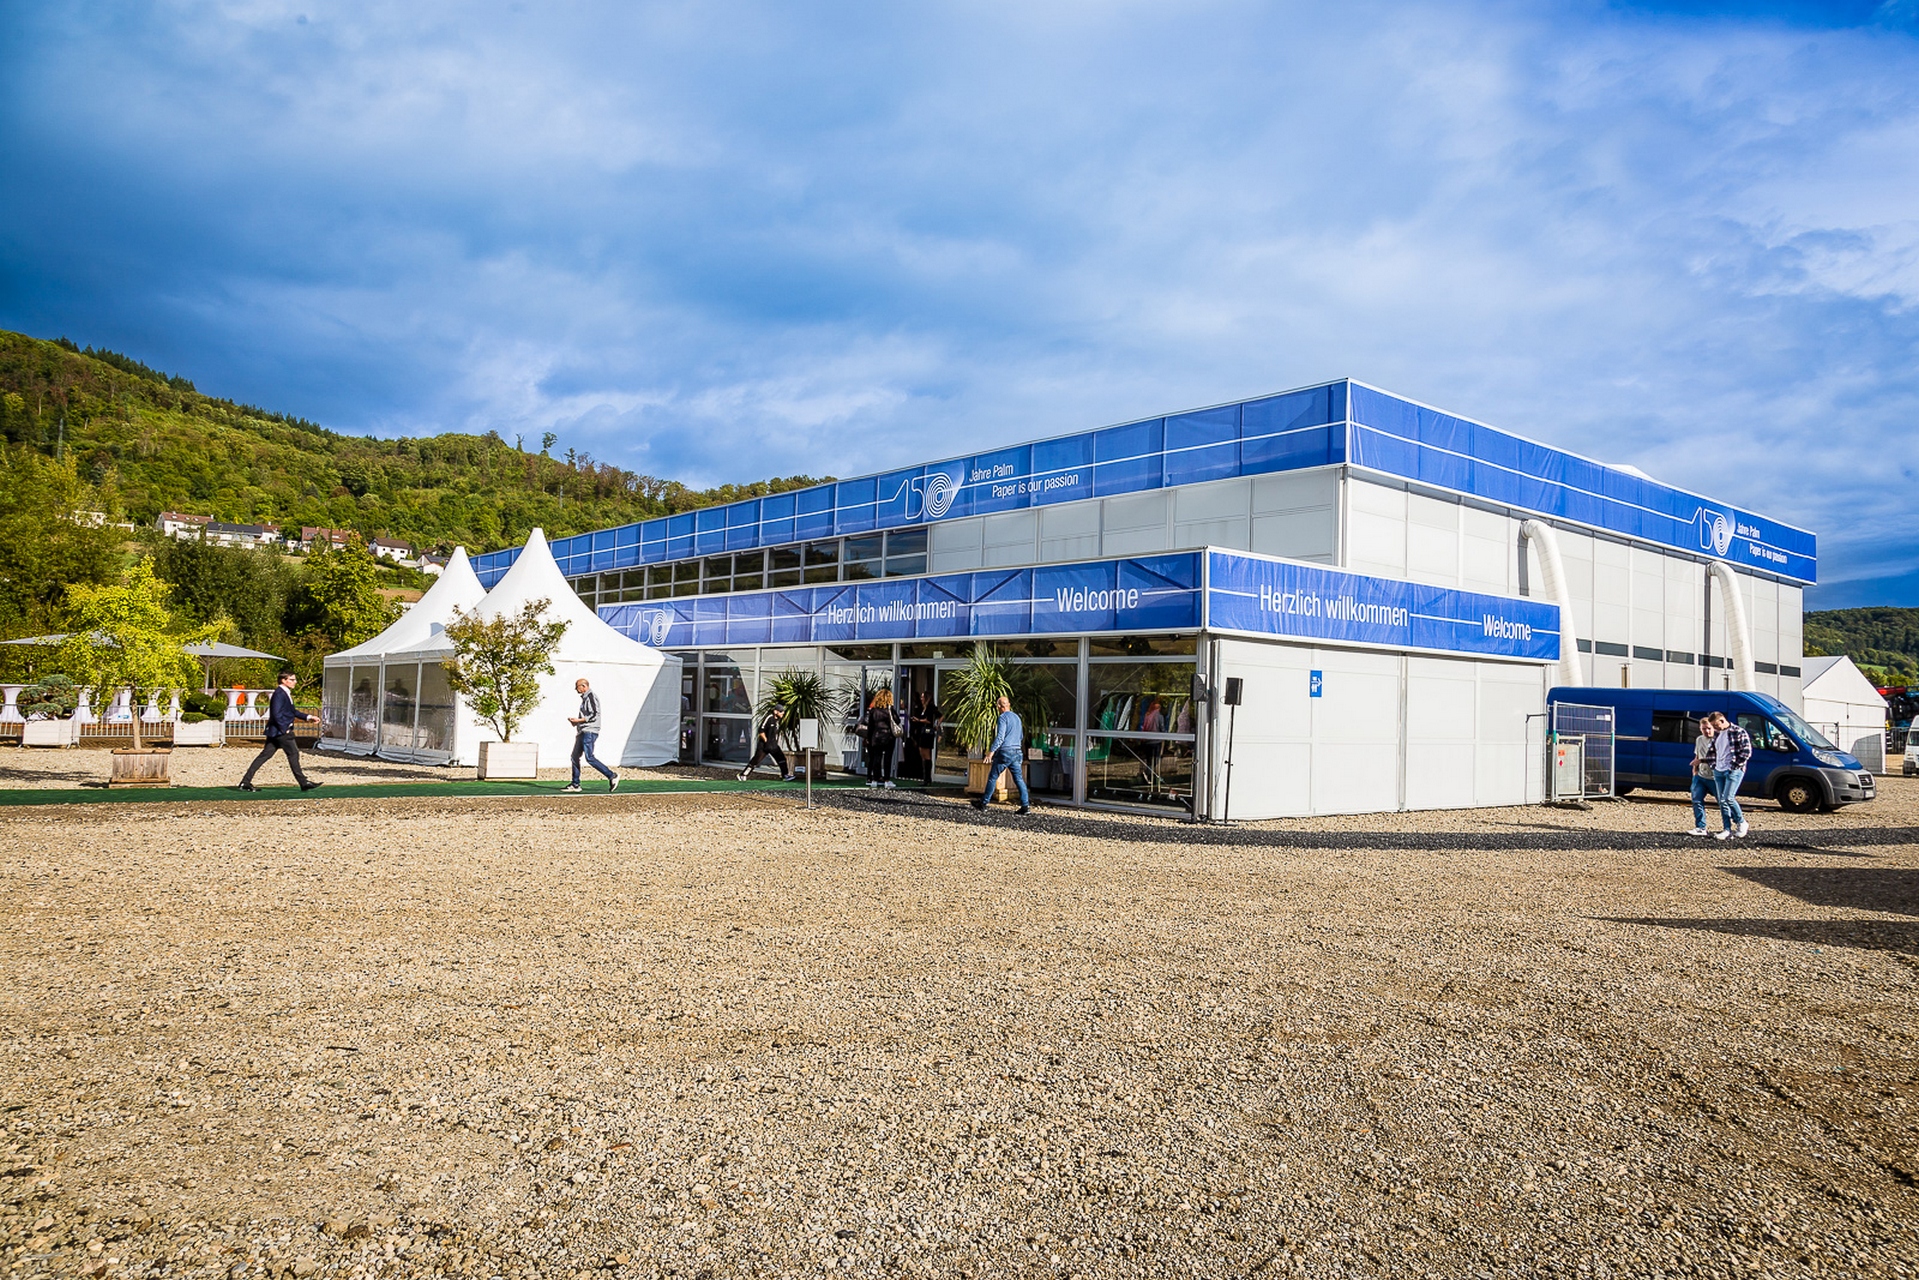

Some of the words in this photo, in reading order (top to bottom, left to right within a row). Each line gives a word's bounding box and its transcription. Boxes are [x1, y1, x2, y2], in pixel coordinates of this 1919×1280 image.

[894, 472, 957, 520] 150
[969, 467, 992, 483] Jahre
[993, 463, 1014, 478] Palm
[992, 484, 1017, 499] Paper
[1018, 481, 1026, 494] is
[1027, 480, 1042, 492] our
[1044, 473, 1079, 492] passion
[1749, 543, 1761, 558] Paper
[828, 602, 875, 624] Herzlich
[879, 600, 956, 622] willkommen
[1056, 586, 1139, 612] Welcome
[1260, 584, 1321, 617] Herzlich
[1325, 595, 1408, 627] willkommen
[1483, 614, 1532, 641] Welcome
